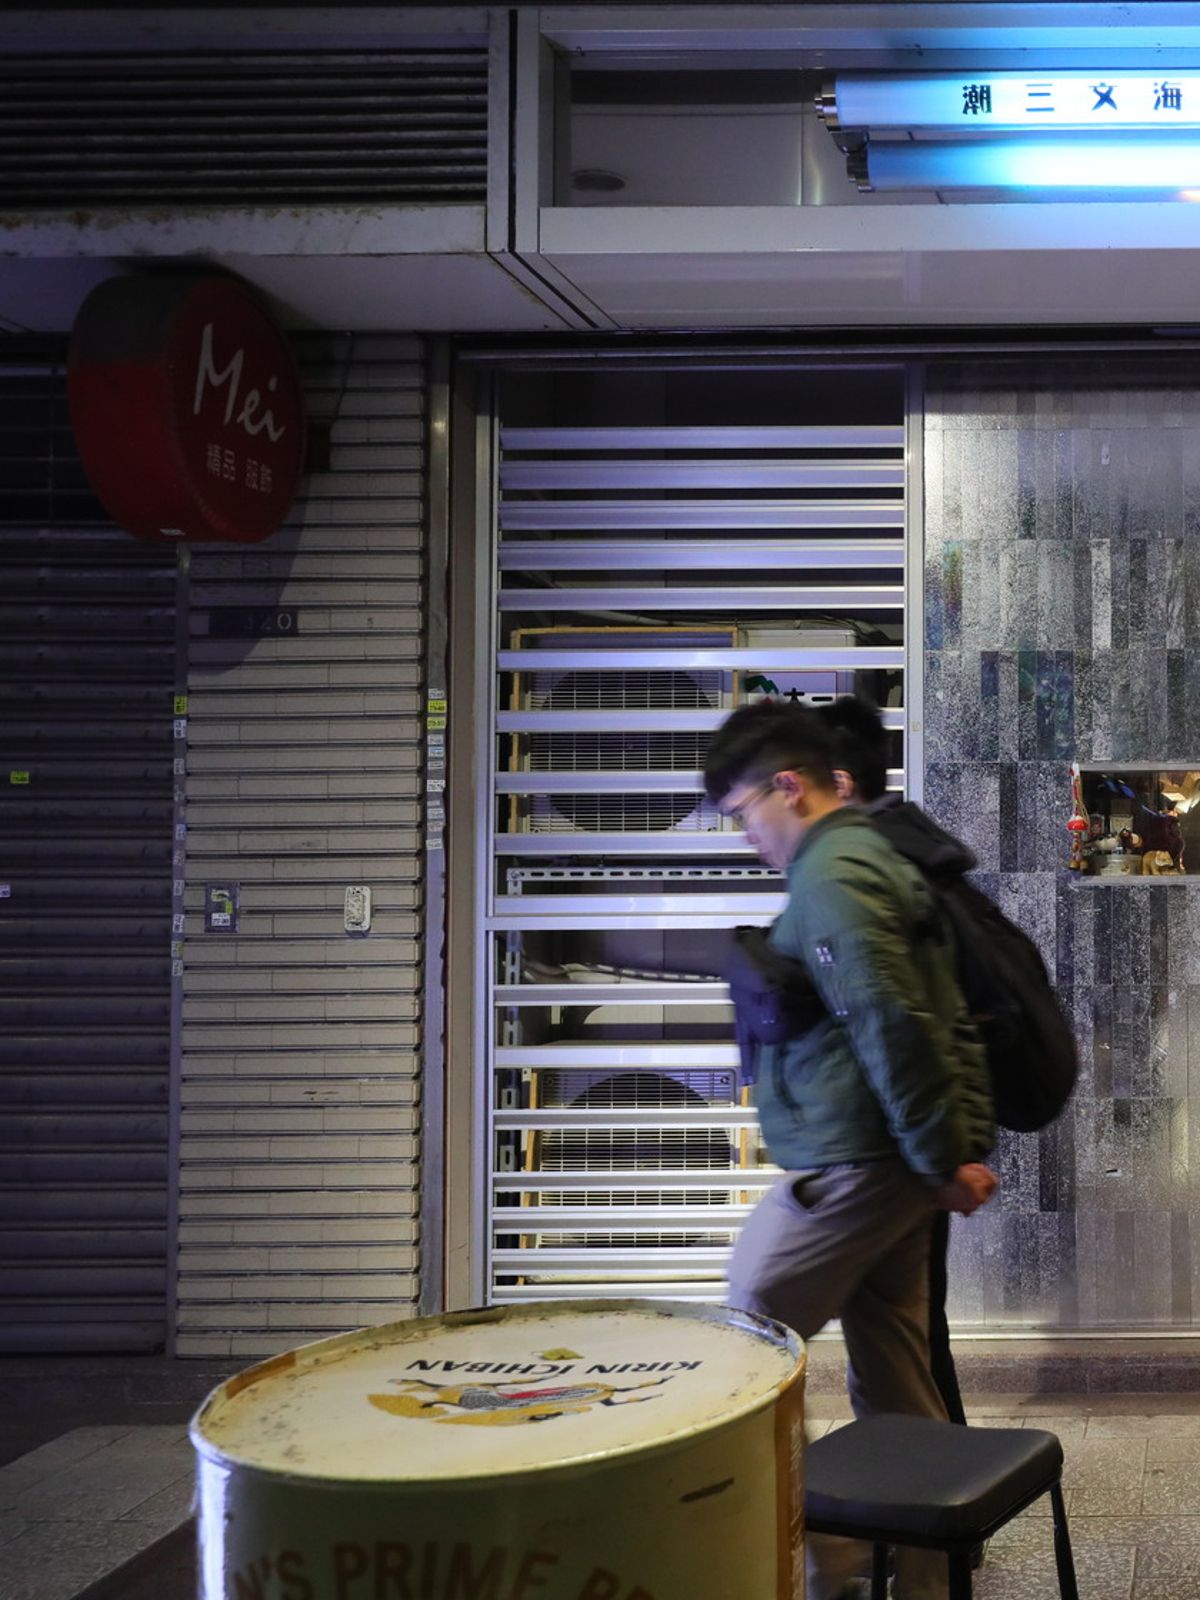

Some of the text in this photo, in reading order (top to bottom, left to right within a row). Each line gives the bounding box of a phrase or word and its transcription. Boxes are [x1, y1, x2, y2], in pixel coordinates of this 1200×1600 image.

[193, 322, 287, 443] Mei
[405, 1359, 704, 1375] KIRIN ICHIBAN
[334, 1541, 561, 1600] PRIME
